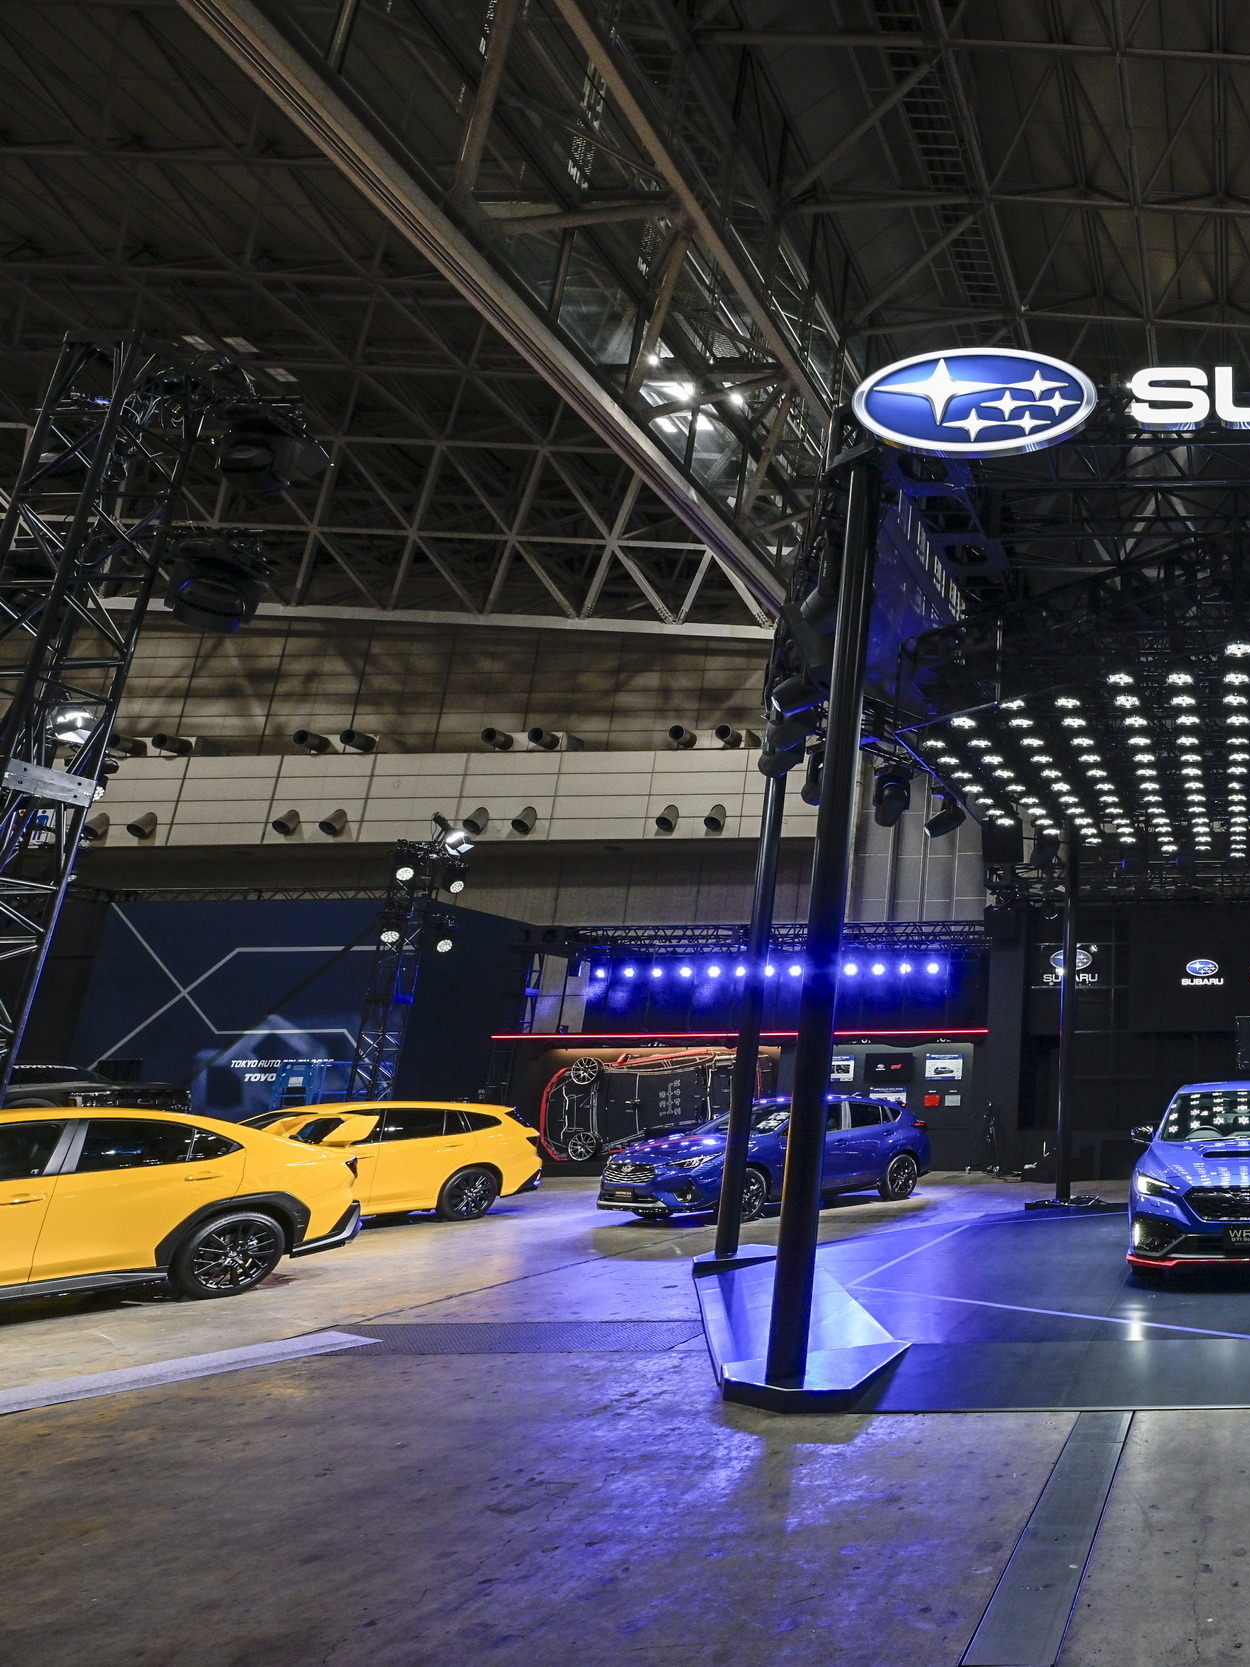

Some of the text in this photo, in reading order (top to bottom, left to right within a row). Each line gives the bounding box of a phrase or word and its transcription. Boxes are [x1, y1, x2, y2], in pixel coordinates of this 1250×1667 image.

[1043, 973, 1098, 983] SURU
[1181, 978, 1224, 986] SUBARU
[230, 1060, 259, 1068] TOKYO
[260, 1060, 281, 1068] AUTO
[244, 1073, 277, 1082] TOYO
